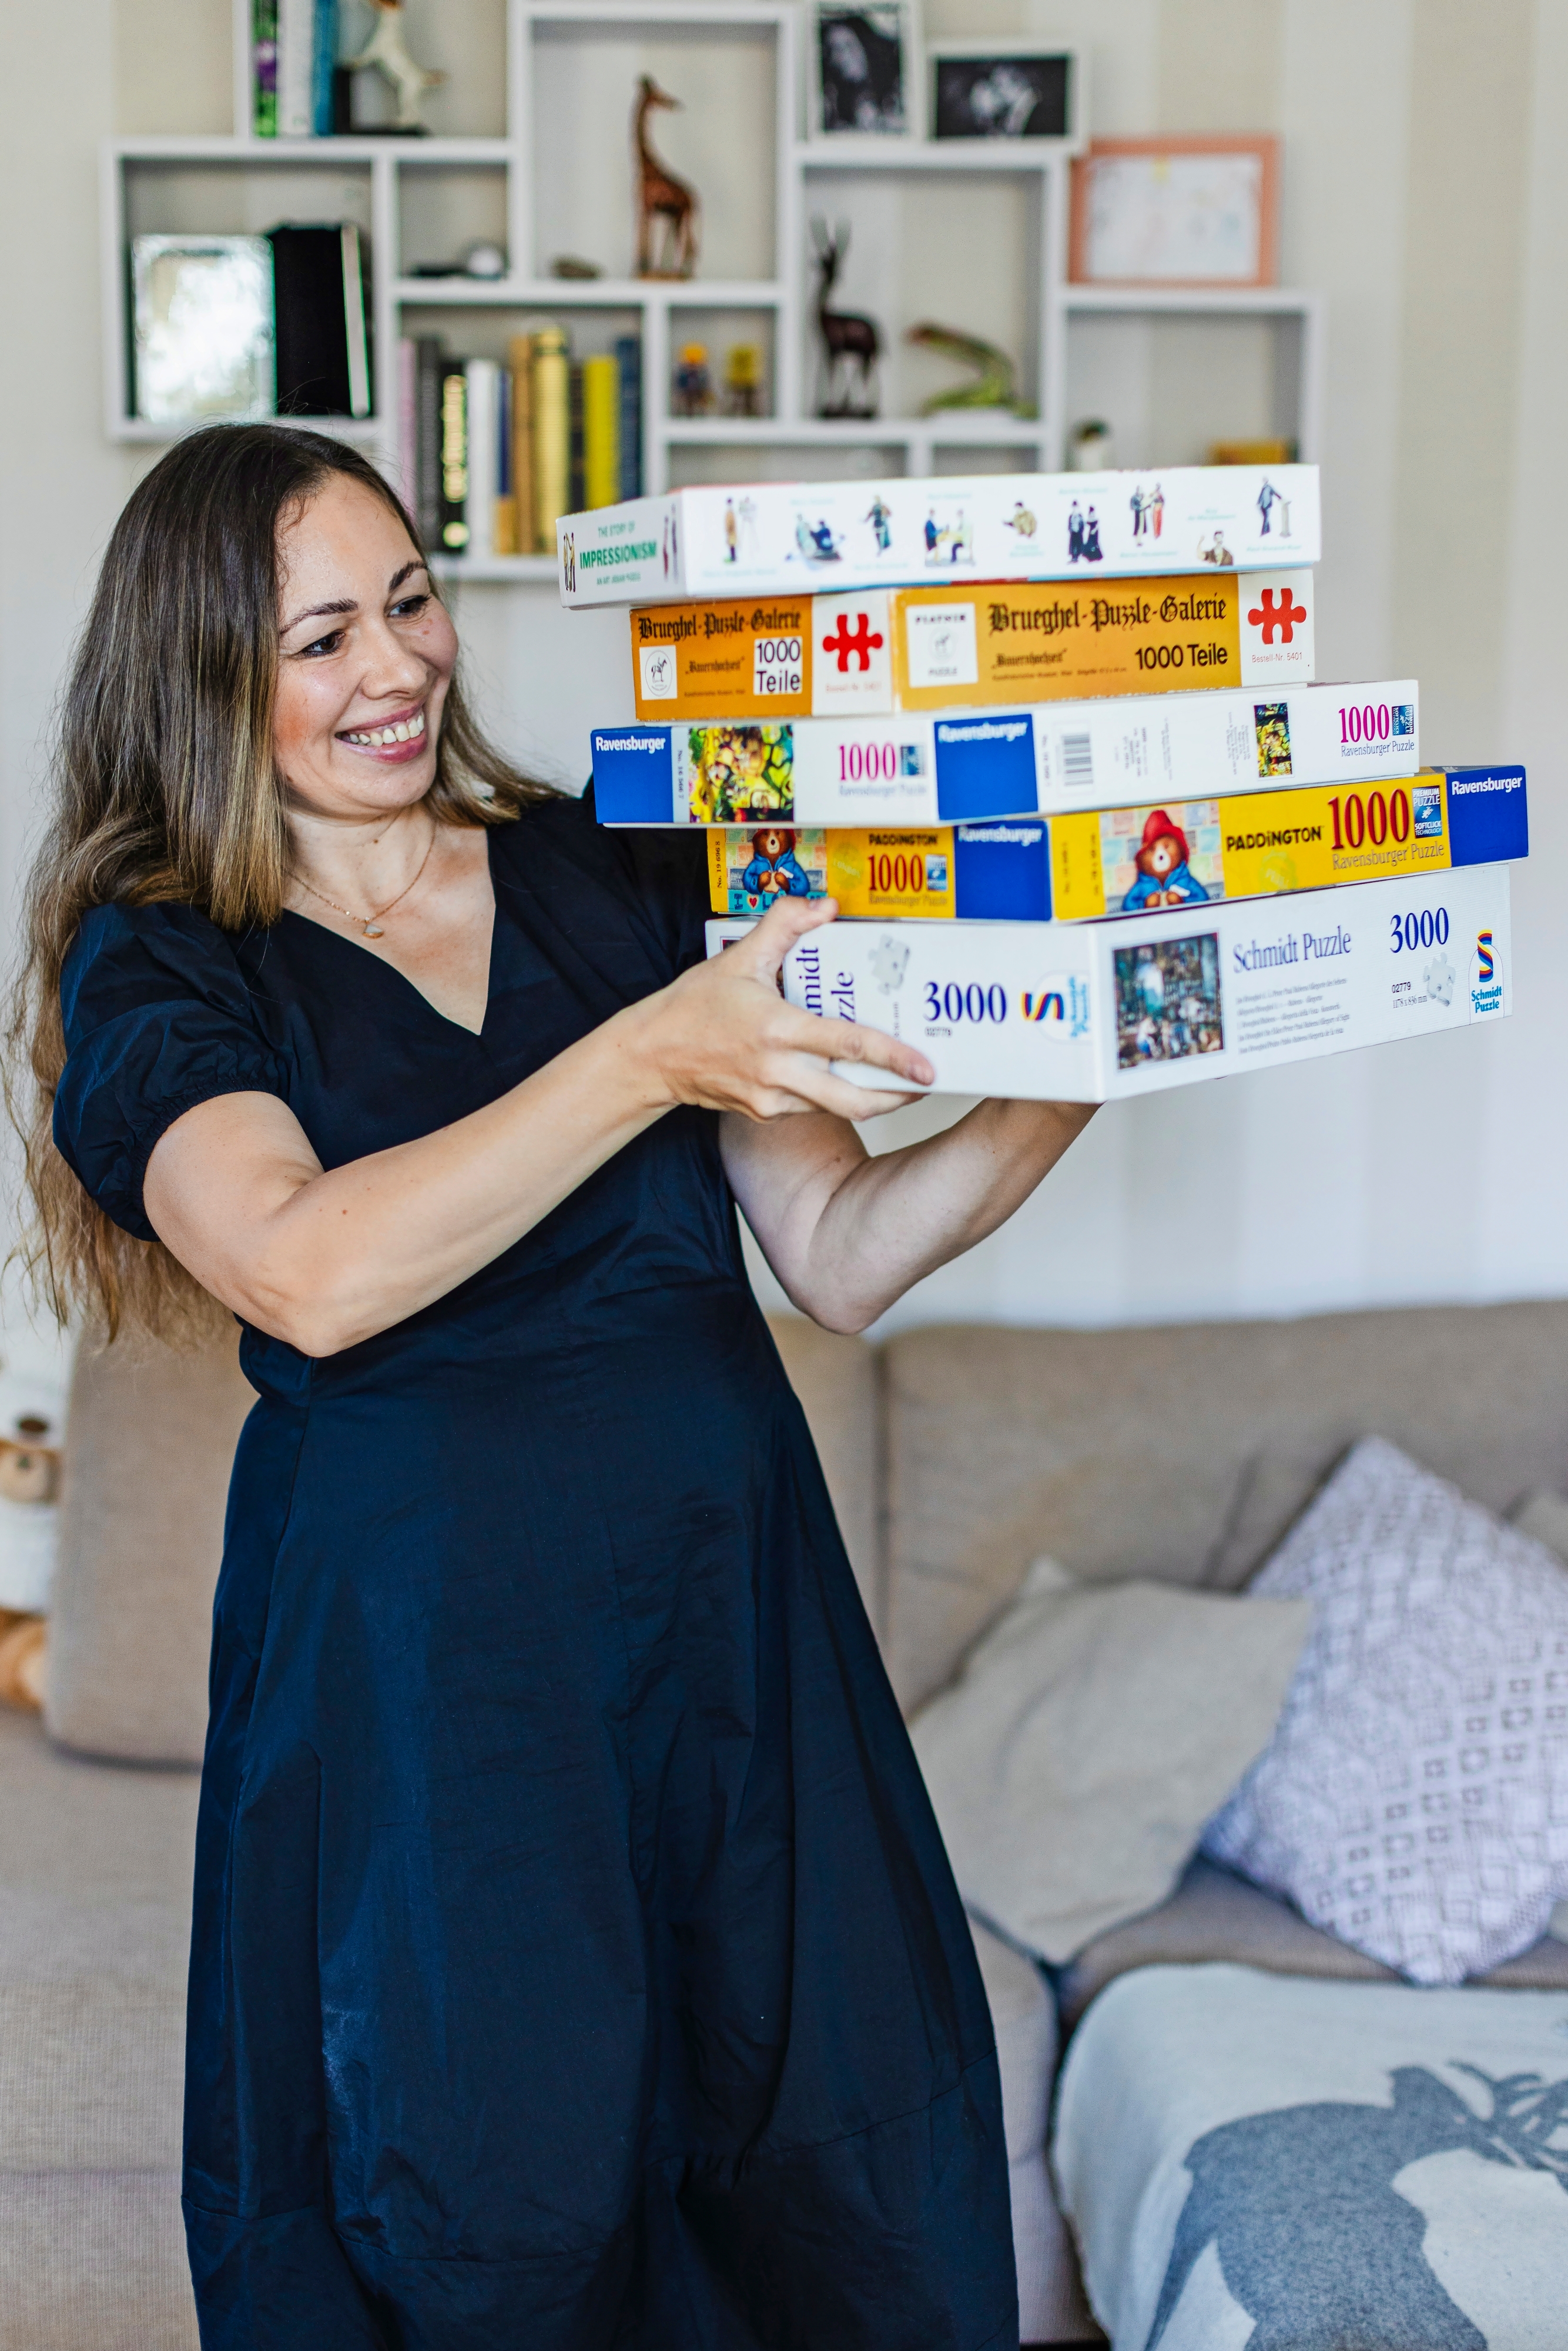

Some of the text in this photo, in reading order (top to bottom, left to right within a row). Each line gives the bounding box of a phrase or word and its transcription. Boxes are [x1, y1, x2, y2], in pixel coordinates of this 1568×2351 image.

[598, 525, 608, 538] THE
[579, 539, 658, 570] IMPRESSIONISM
[756, 639, 801, 664] 1000
[1135, 642, 1228, 671] 1000 Teile
[1252, 652, 1303, 663] Bestell-Nr. 5401
[756, 669, 800, 693] Teile
[938, 722, 1028, 743] Ravensburger
[1339, 704, 1390, 743] 1000
[596, 735, 666, 754] Ravensburger
[1341, 739, 1415, 757] Ravensburger Puzzle
[839, 744, 896, 781] 1000
[1413, 788, 1439, 798] PREMIUM
[1452, 777, 1523, 795] Ravensburger
[1413, 795, 1440, 807] PUZZLE
[1328, 788, 1409, 850] 1000
[1415, 820, 1442, 830] SOFTCLICK
[958, 824, 1043, 846] Ravensburger
[1332, 840, 1444, 870] Ravensburger Puzzle
[868, 854, 923, 892] 1000
[1390, 907, 1449, 953] 3000
[1233, 925, 1352, 973] Schmidt Puzzle
[1392, 982, 1411, 993] 02779
[1471, 986, 1502, 1002] Schmidt
[922, 980, 1007, 1024] 3000
[1418, 995, 1427, 1004] mm
[1475, 999, 1500, 1014] Puzzle
